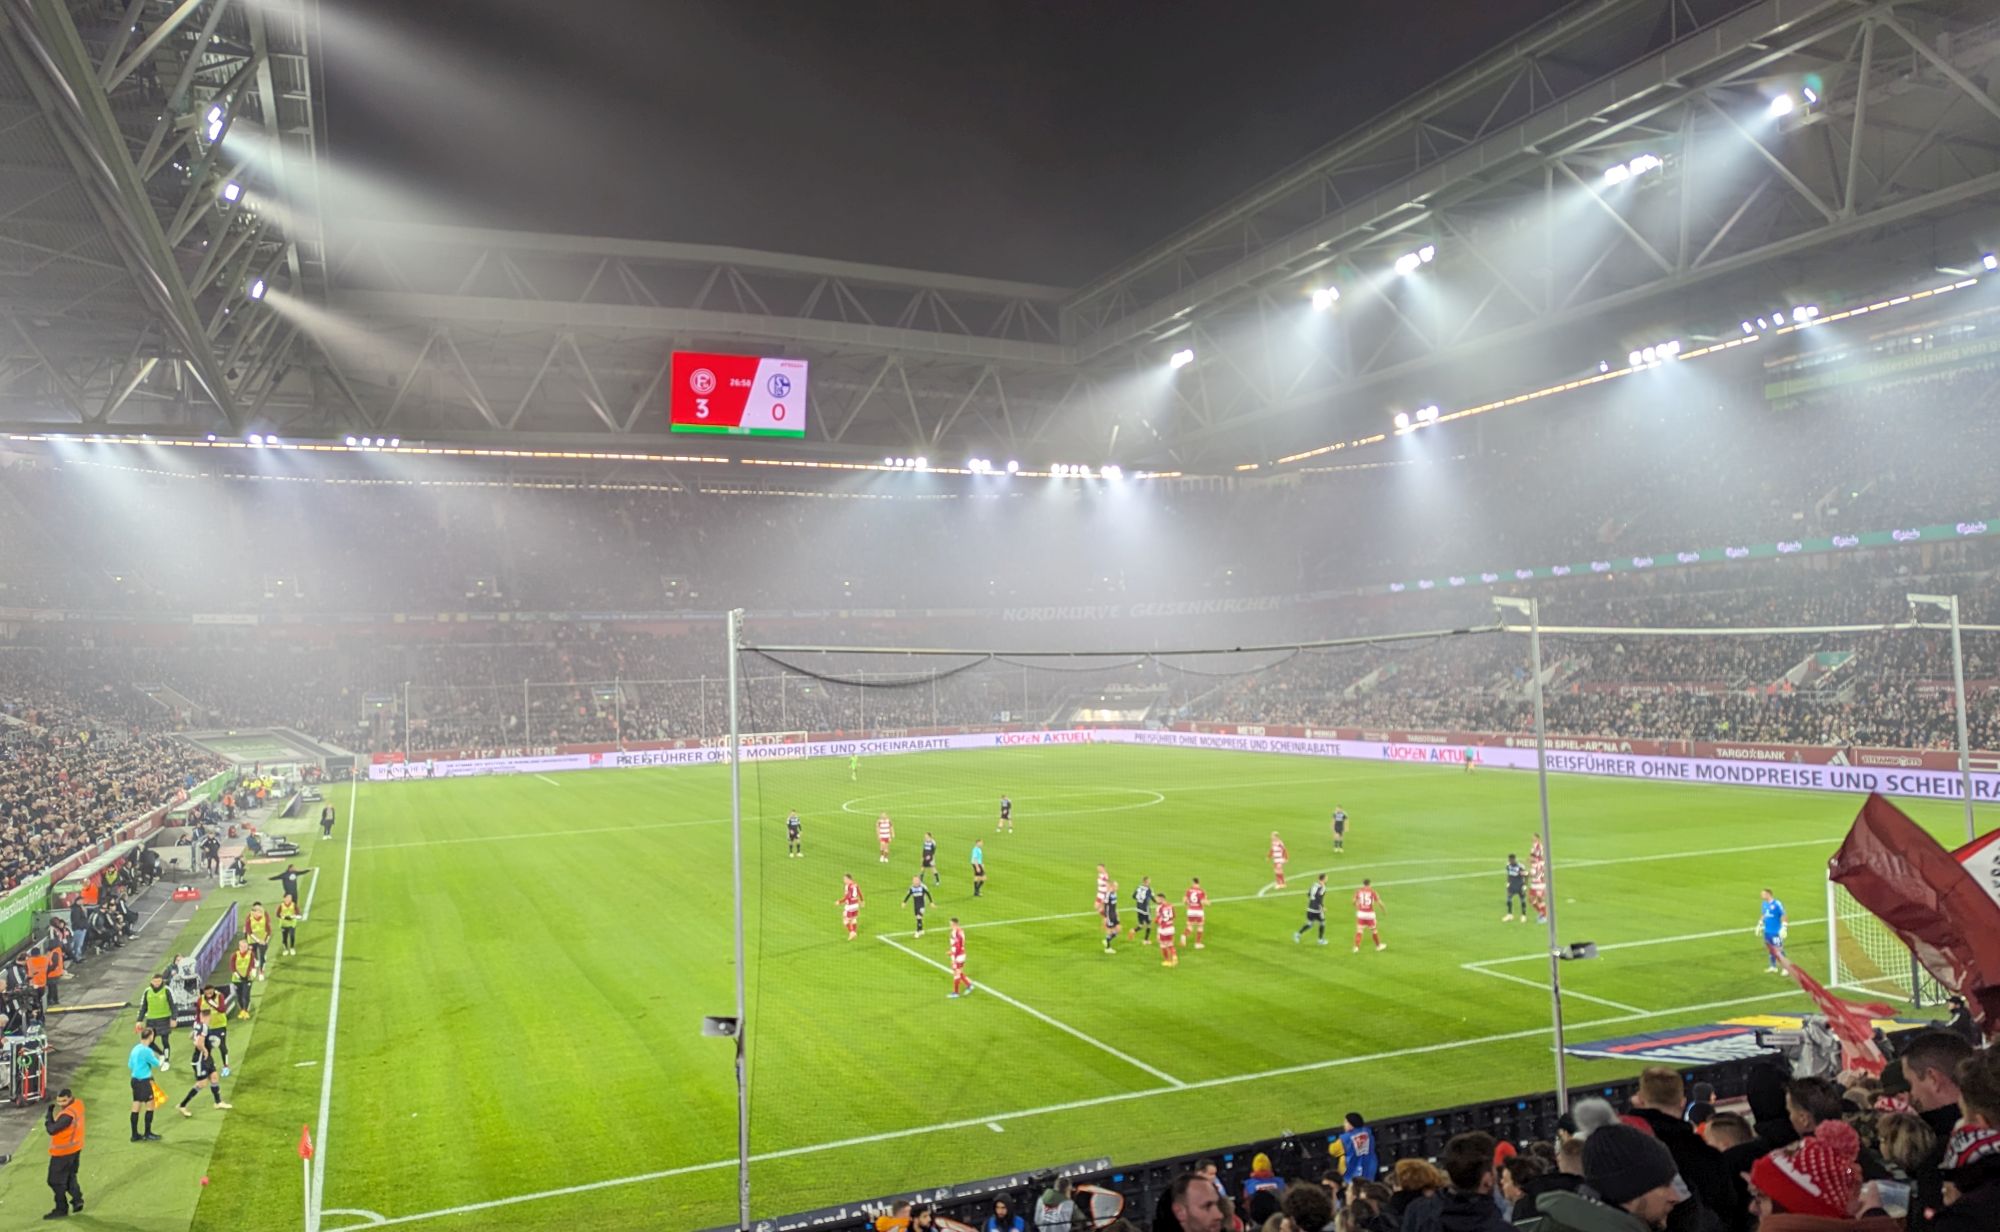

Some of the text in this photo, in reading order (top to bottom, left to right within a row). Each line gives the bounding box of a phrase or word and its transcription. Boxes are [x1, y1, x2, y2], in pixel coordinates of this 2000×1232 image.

[695, 398, 709, 419] 3
[772, 403, 785, 421] 0
[830, 742, 856, 755] UND
[860, 737, 950, 752] SCHEINRABATTE
[1546, 752, 1637, 774] REISFÜHRER
[1641, 760, 1690, 778] OHNE
[1695, 763, 1823, 787] MONDPREISE
[1830, 771, 1879, 791] UND
[1189, 890, 1199, 905] 6
